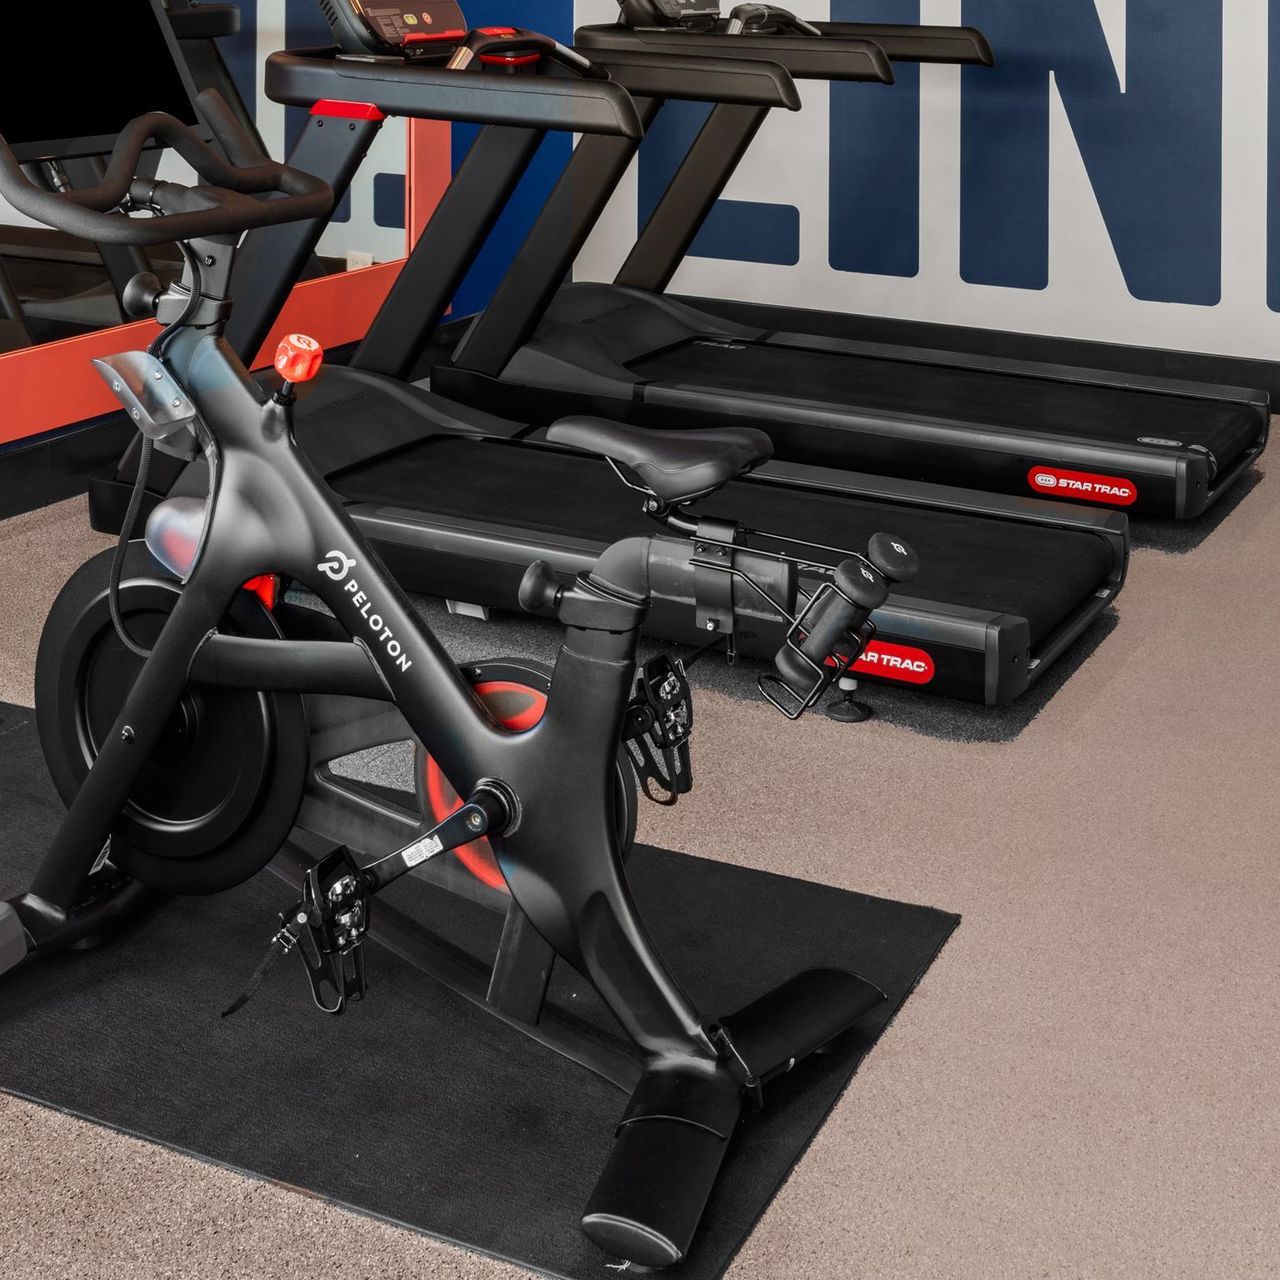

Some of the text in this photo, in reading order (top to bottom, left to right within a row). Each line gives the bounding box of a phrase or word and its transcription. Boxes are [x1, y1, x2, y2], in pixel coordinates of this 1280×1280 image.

[1058, 478, 1130, 497] STAR TRAC
[344, 579, 413, 672] PELOTON
[881, 654, 926, 672] TRAC
